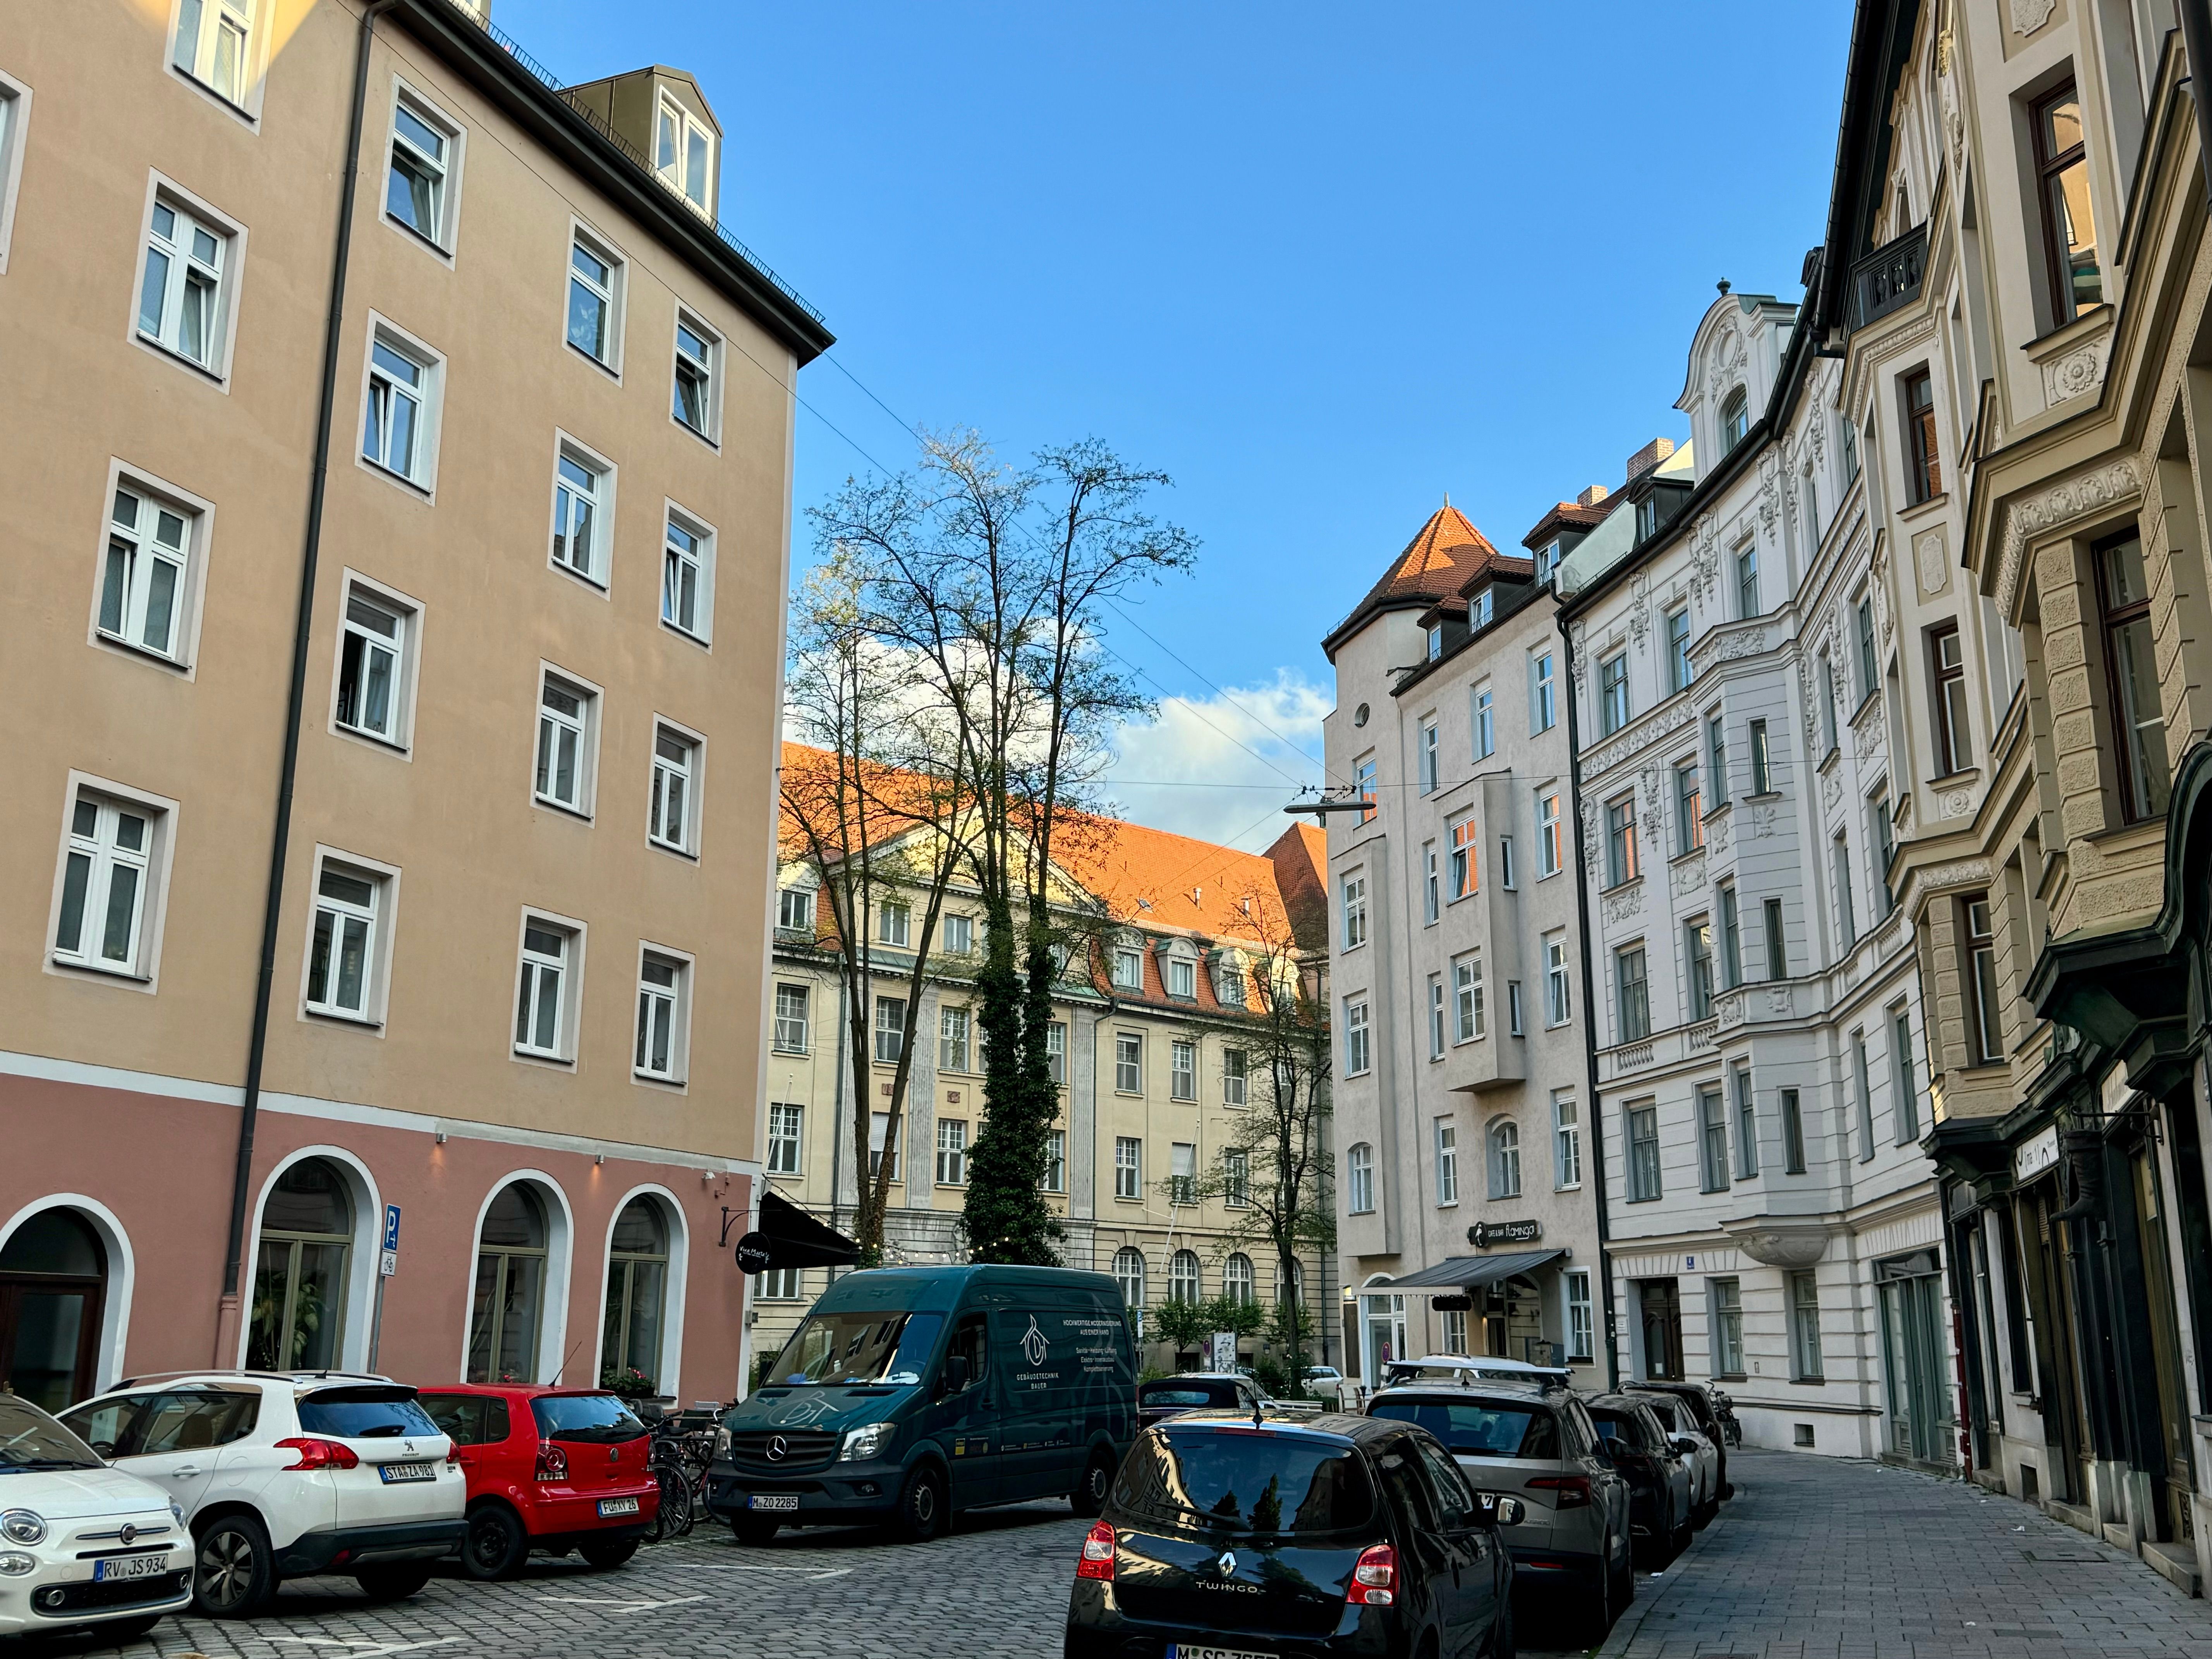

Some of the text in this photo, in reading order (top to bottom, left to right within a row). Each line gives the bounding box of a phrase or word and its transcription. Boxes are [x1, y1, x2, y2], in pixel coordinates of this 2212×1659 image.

[386, 1210, 396, 1243] P
[1017, 1372, 1059, 1381] GEBÄUDETECHNIK
[386, 1466, 404, 1479] STA
[407, 1466, 419, 1477] ZA
[419, 1465, 434, 1477] 981
[617, 1500, 626, 1511] XY
[627, 1499, 636, 1510] 26
[753, 1498, 759, 1507] M
[775, 1498, 797, 1508] 2285
[104, 1557, 166, 1578] RV JS 934
[1196, 1581, 1258, 1593] TWINGO
[1178, 1647, 1189, 1659] M
